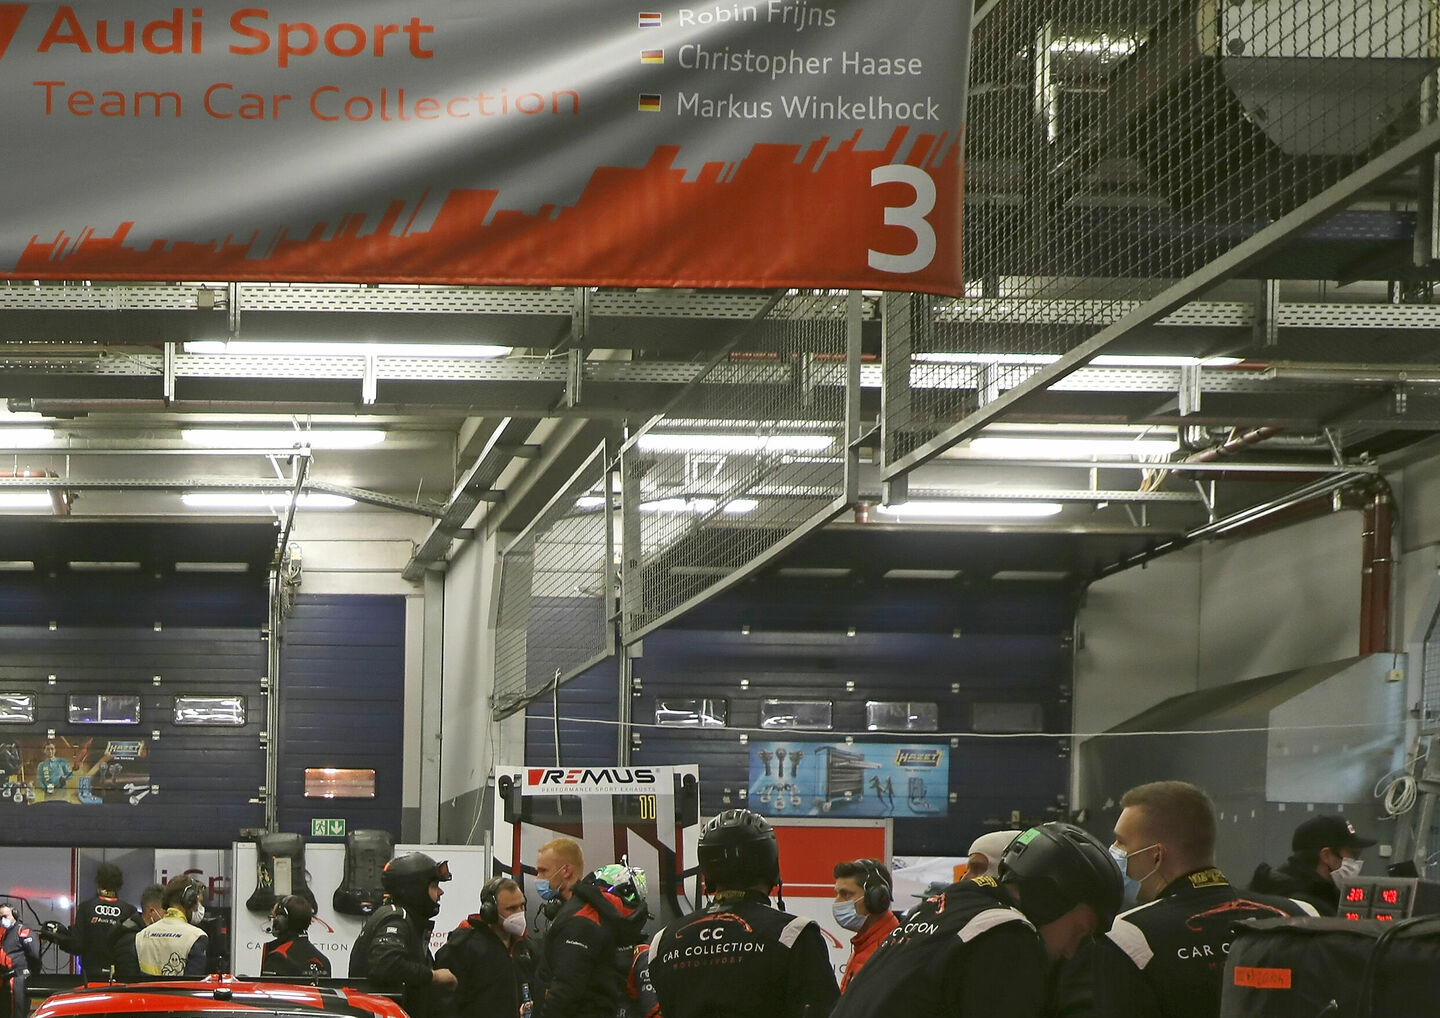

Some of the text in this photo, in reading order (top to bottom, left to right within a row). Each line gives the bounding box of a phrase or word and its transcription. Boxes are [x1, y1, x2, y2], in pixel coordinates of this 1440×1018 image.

[679, 1, 835, 32] Robin Frijns
[37, 6, 434, 68] Audi Sport
[678, 44, 922, 80] Christopher Haase
[33, 81, 579, 122] Team Car Collection
[677, 92, 939, 121] Markus Winkelhock
[868, 164, 937, 274] 3
[542, 769, 656, 785] REMUS
[639, 795, 657, 820] 11
[699, 927, 725, 941] CC
[663, 942, 765, 963] CAR COLLECTION
[1177, 944, 1215, 959] CAR
